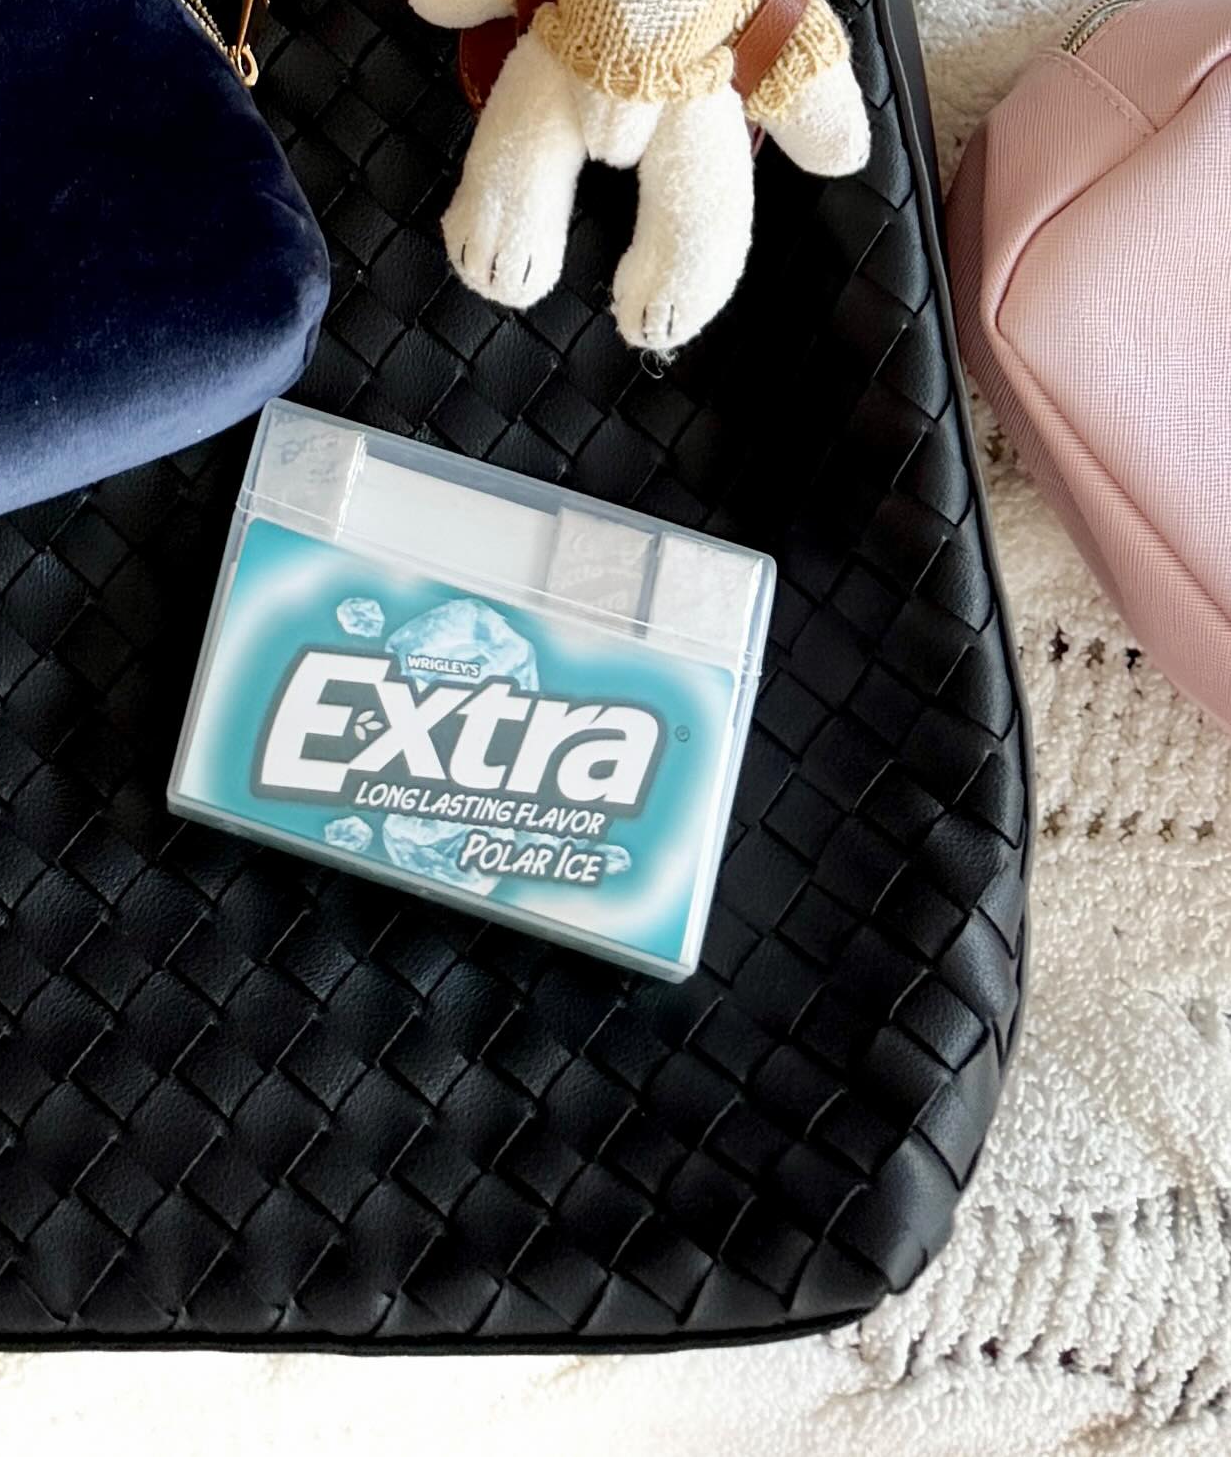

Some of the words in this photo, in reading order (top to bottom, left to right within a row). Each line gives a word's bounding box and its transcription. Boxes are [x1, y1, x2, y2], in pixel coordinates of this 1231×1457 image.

[405, 653, 481, 679] WRIGLEY'S
[259, 650, 660, 806] Extra
[354, 781, 421, 813] LONG
[418, 789, 514, 825] LASTING
[514, 803, 606, 836] FLAVOR
[459, 836, 553, 878] POLAR
[558, 840, 604, 883] ICE
